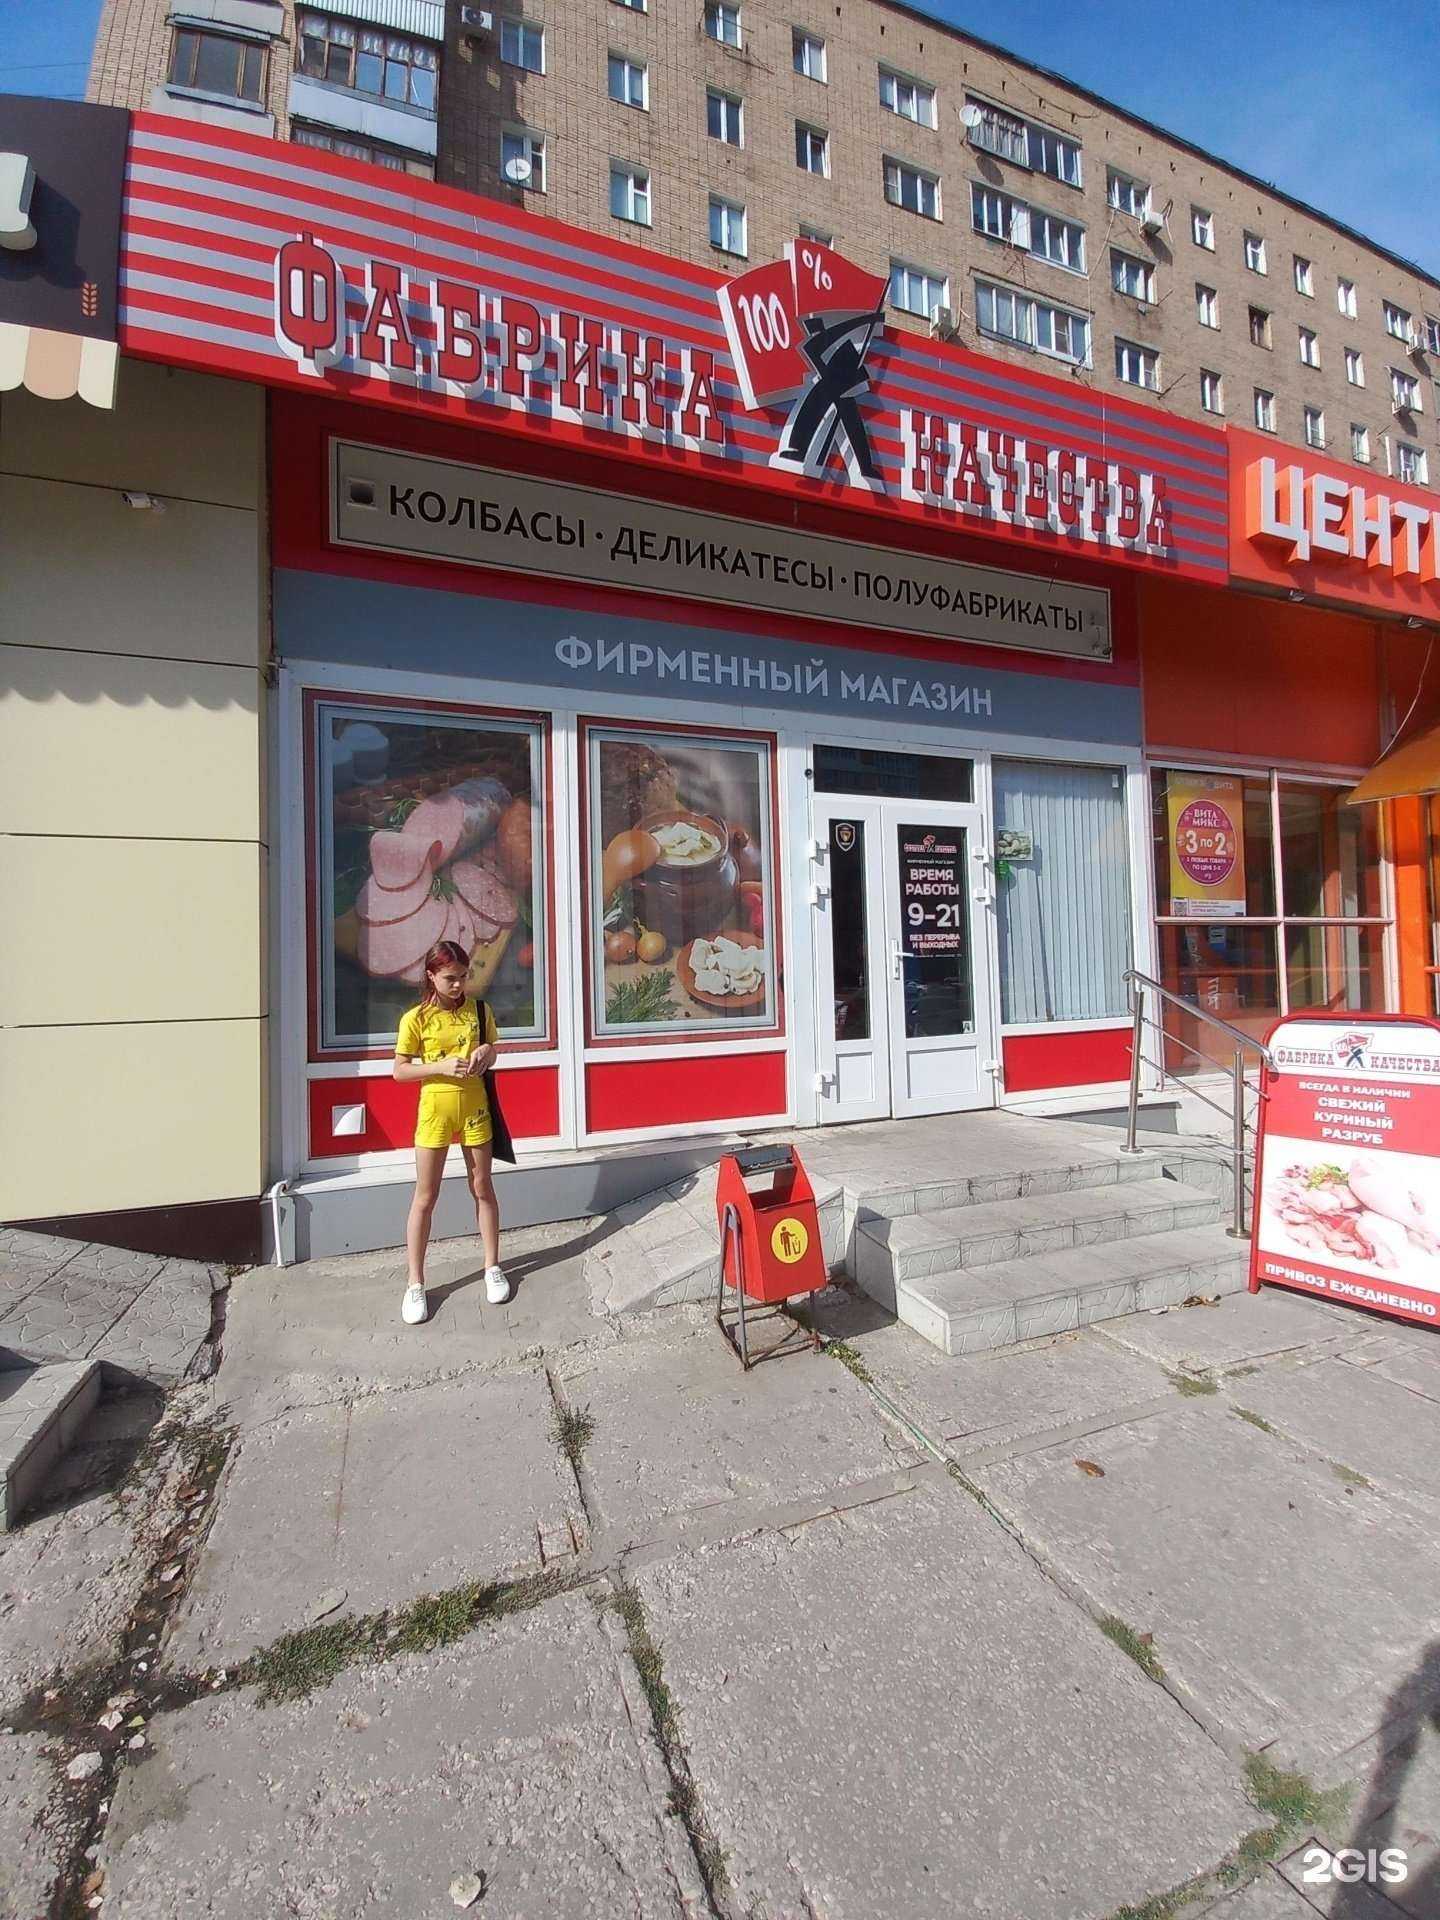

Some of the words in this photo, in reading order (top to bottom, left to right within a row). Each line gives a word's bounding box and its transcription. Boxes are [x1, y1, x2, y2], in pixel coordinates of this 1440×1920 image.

[738, 292, 790, 354] 100
[276, 231, 726, 452] ФАБРИКА
[903, 409, 1173, 556] КАЧЕСТВА
[1248, 456, 1440, 582] ЦЕНТ
[389, 484, 585, 548] КОЛБАСЫ
[610, 526, 834, 591] ДЕЛИКАТЕСЫ
[854, 571, 1083, 633] ПОЛУФАБРИКАТЫ
[554, 635, 829, 697] ФИРМЕННЫЙ
[840, 669, 993, 716] МАГАЗИН
[1186, 830, 1198, 854] 3
[1214, 832, 1227, 856] 2
[910, 869, 954, 881] ВРЕМЯ
[905, 884, 960, 896] РАБОТЫ
[907, 902, 960, 927] 9-21
[1277, 1049, 1335, 1066] ФАБРИКА
[1370, 1055, 1440, 1073] КАЧЕСТВА
[1299, 1081, 1340, 1093] ВСЕГДА
[1342, 1084, 1352, 1094] В
[1353, 1086, 1411, 1099] НАЛИЧИИ
[1318, 1097, 1387, 1113] СВЕЖИЙ
[1314, 1112, 1394, 1130] КУРИНЫЙ
[1321, 1127, 1383, 1145] РАЗРУБ
[1265, 1262, 1327, 1288] ПРИВОЗ
[1329, 1279, 1437, 1316] ЕЖЕДНЕВНО
